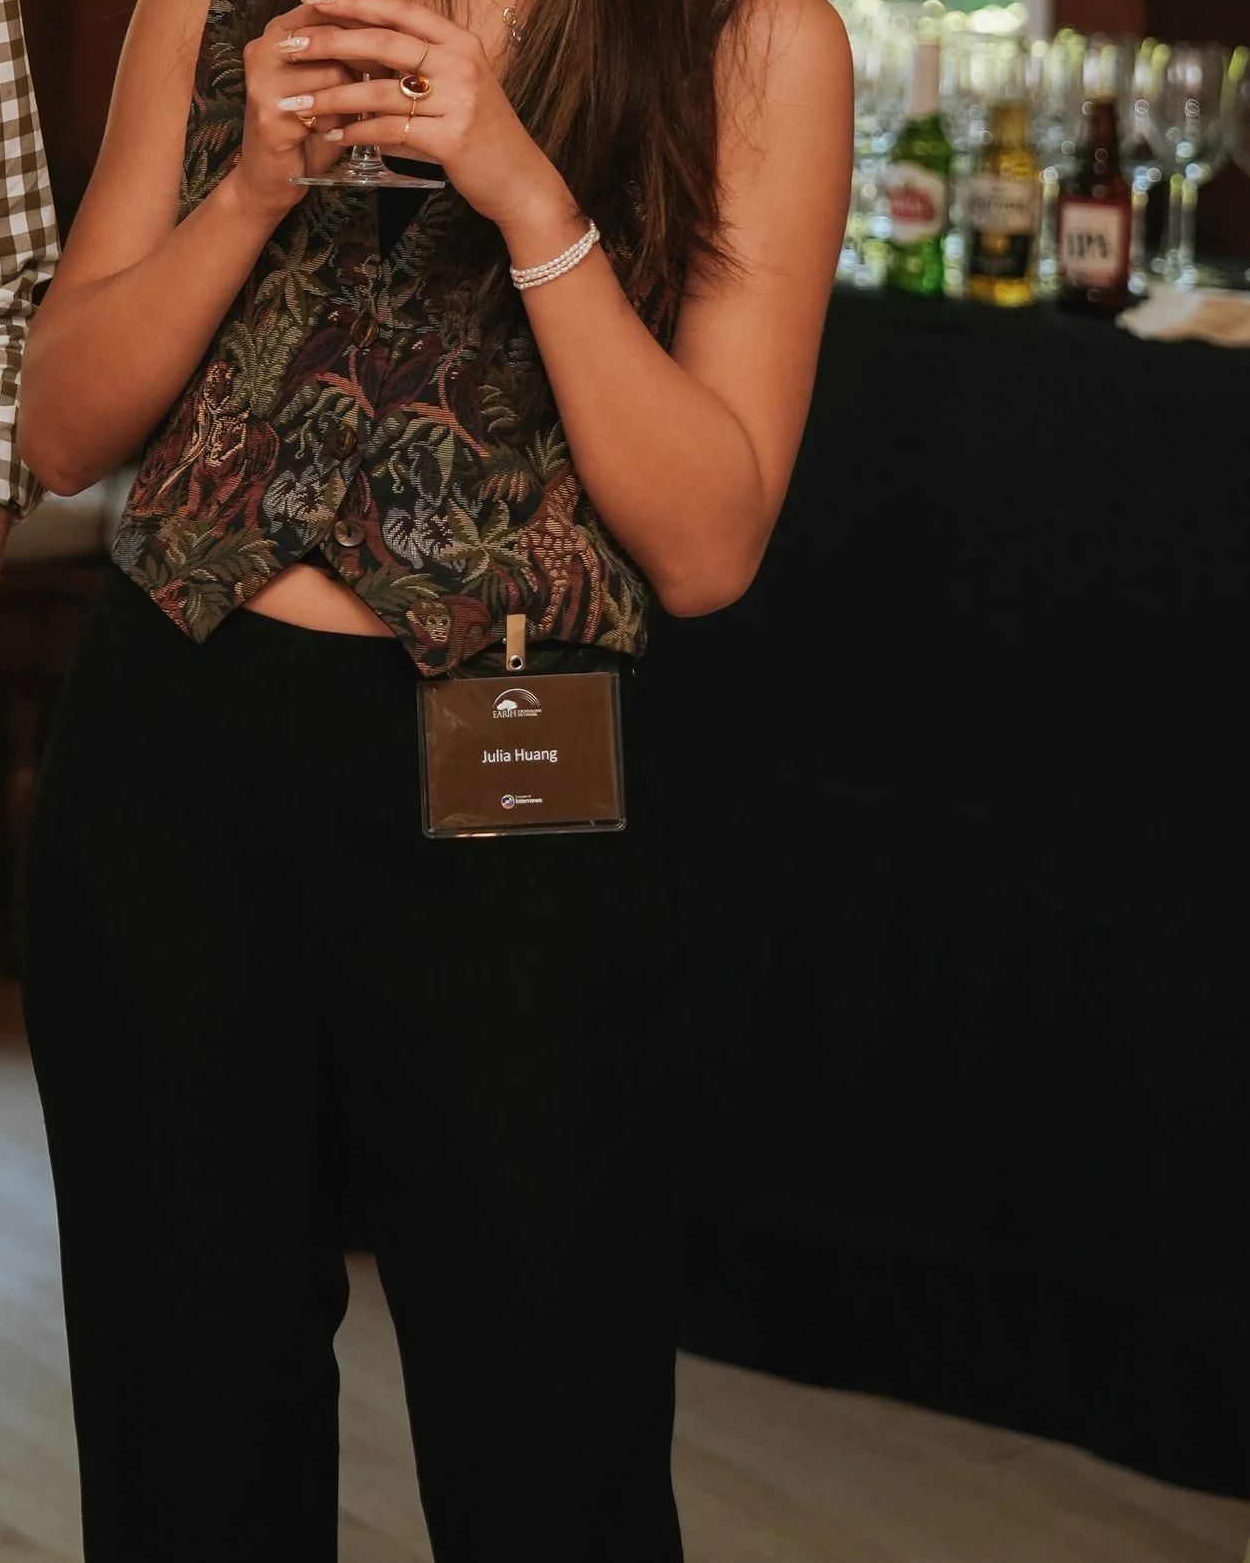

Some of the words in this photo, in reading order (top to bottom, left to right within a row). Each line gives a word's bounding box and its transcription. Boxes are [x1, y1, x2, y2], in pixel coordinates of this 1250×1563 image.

[492, 710, 517, 719] EARTH
[482, 749, 511, 763] Julia
[514, 748, 558, 763] Huang
